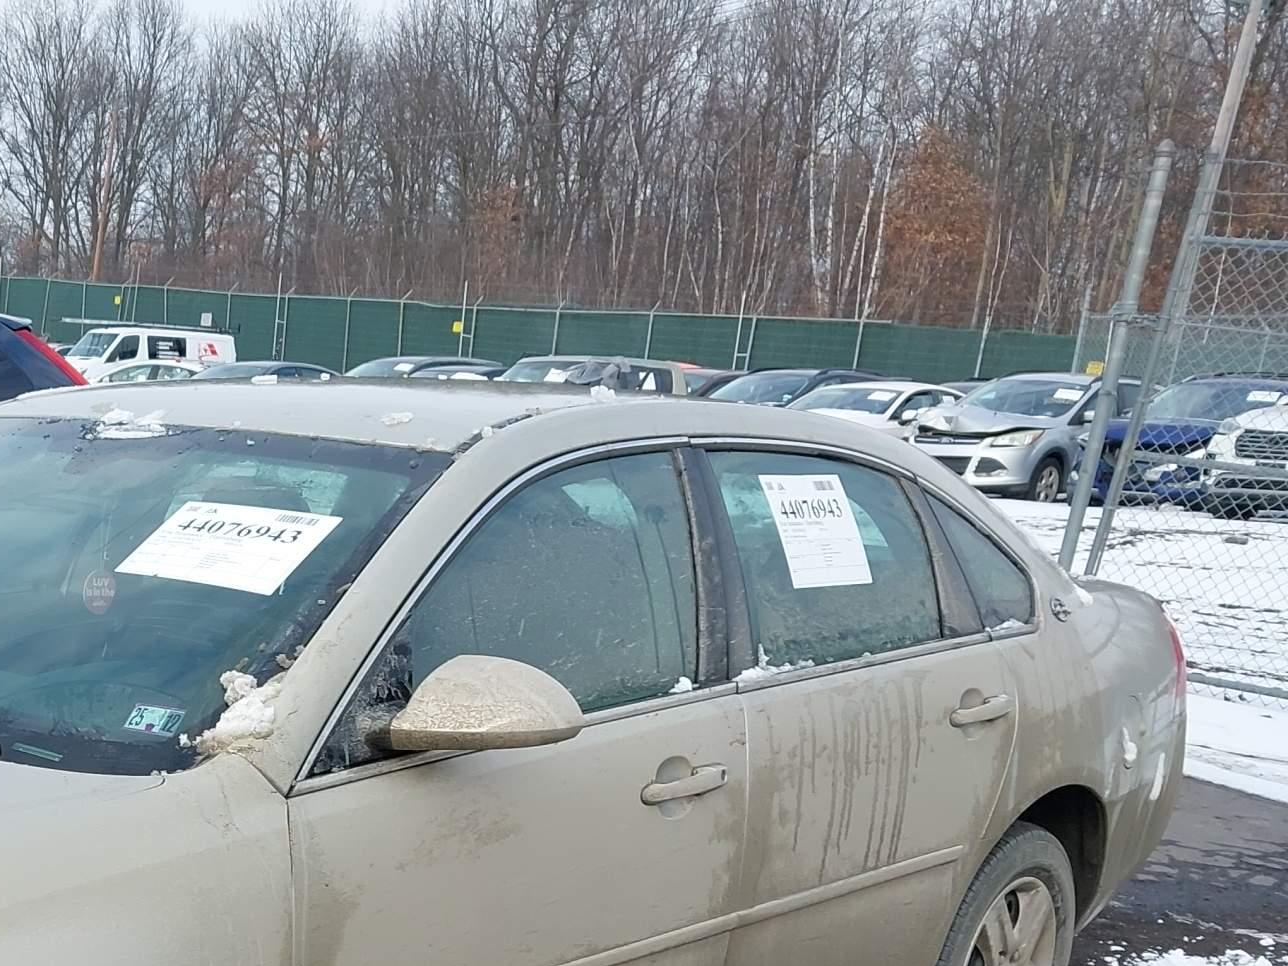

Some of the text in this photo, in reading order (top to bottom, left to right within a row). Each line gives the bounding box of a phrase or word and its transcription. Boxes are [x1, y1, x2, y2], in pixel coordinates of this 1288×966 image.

[780, 497, 843, 519] 44076943
[177, 517, 303, 544] 44076943
[128, 707, 149, 726] 25
[160, 713, 182, 733] 12
